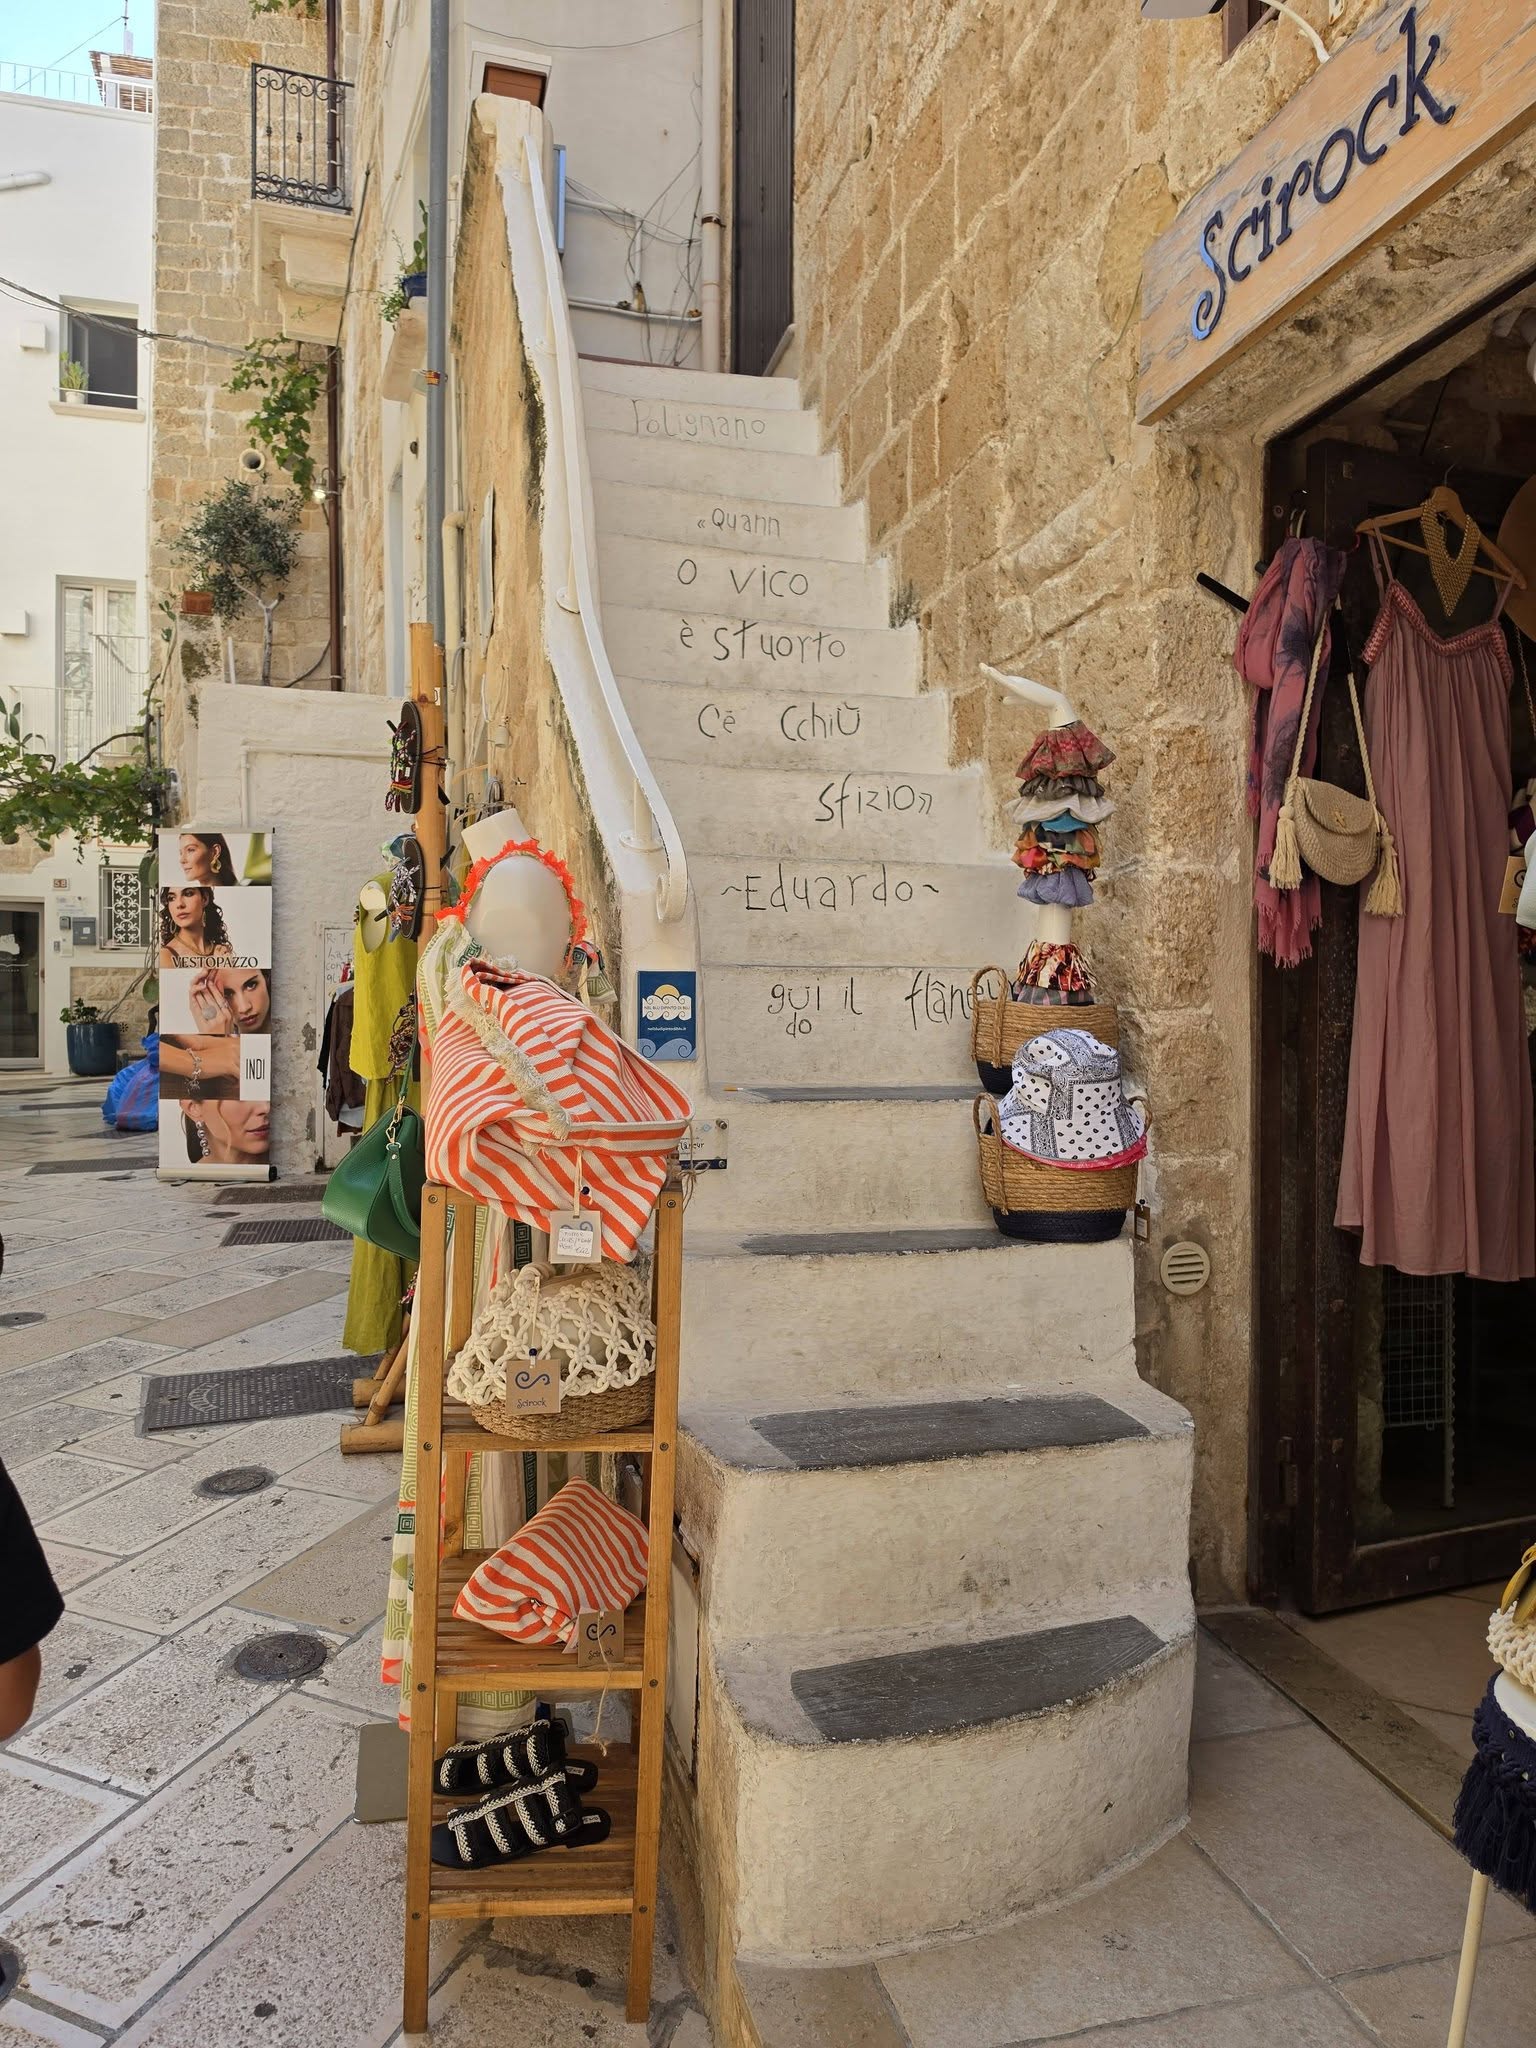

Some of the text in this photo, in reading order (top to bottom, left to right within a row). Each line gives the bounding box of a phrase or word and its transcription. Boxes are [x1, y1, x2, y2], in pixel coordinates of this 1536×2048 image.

[1190, 7, 1456, 341] Scirock
[631, 398, 766, 440] Polignano
[730, 564, 808, 598] vico
[680, 618, 694, 649] è
[172, 956, 259, 969] VESTOPAZZO
[844, 976, 863, 1016] il
[785, 1011, 812, 1039] do
[245, 1058, 266, 1081] INDI
[516, 1397, 547, 1409] Scirock
